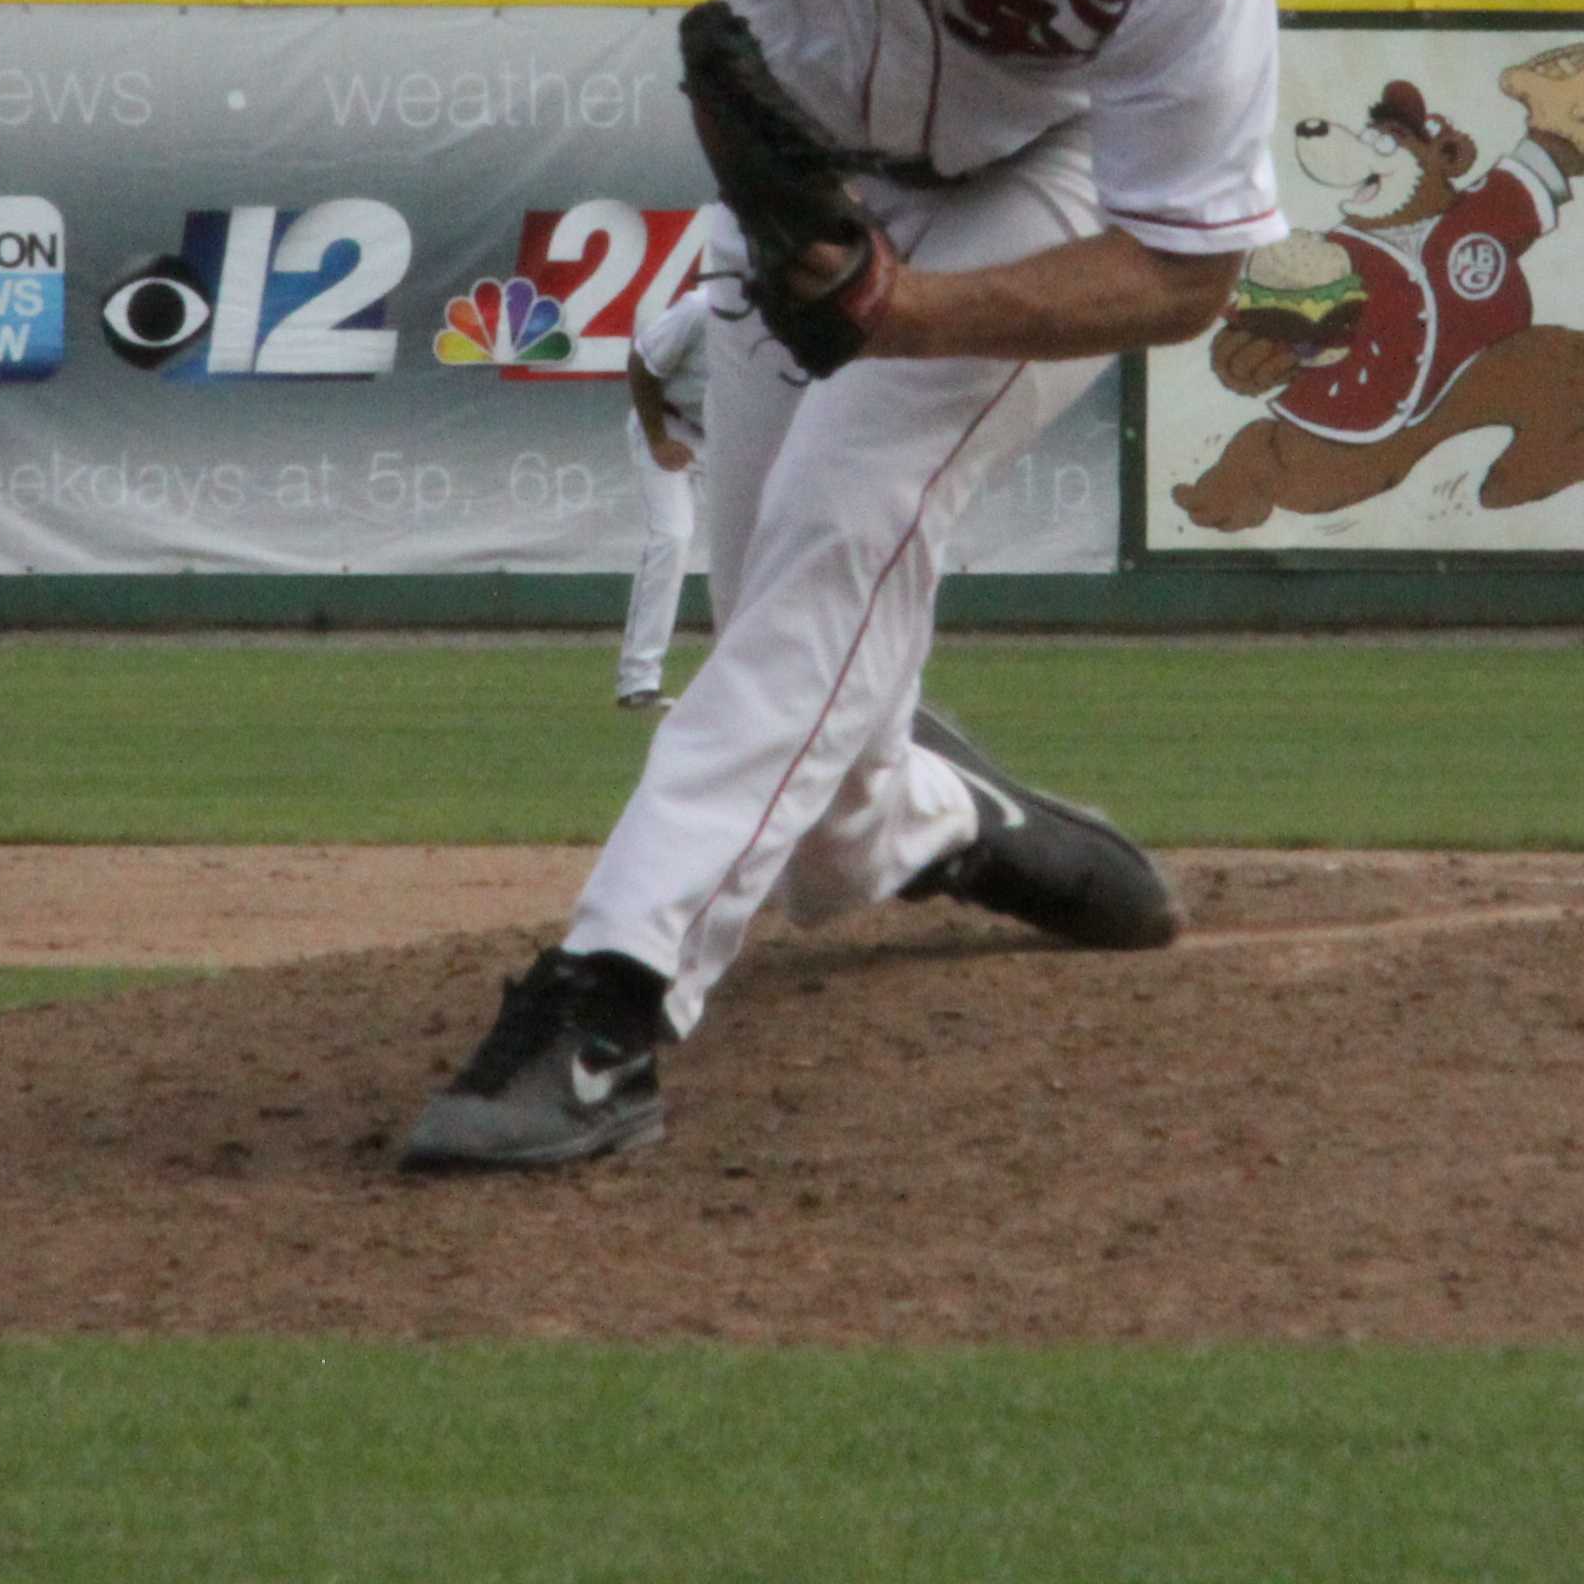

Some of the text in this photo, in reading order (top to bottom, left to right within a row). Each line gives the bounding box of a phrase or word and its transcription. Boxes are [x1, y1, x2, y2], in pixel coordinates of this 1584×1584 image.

[324, 56, 657, 129] weather
[207, 198, 413, 374] 12
[274, 456, 336, 513] at
